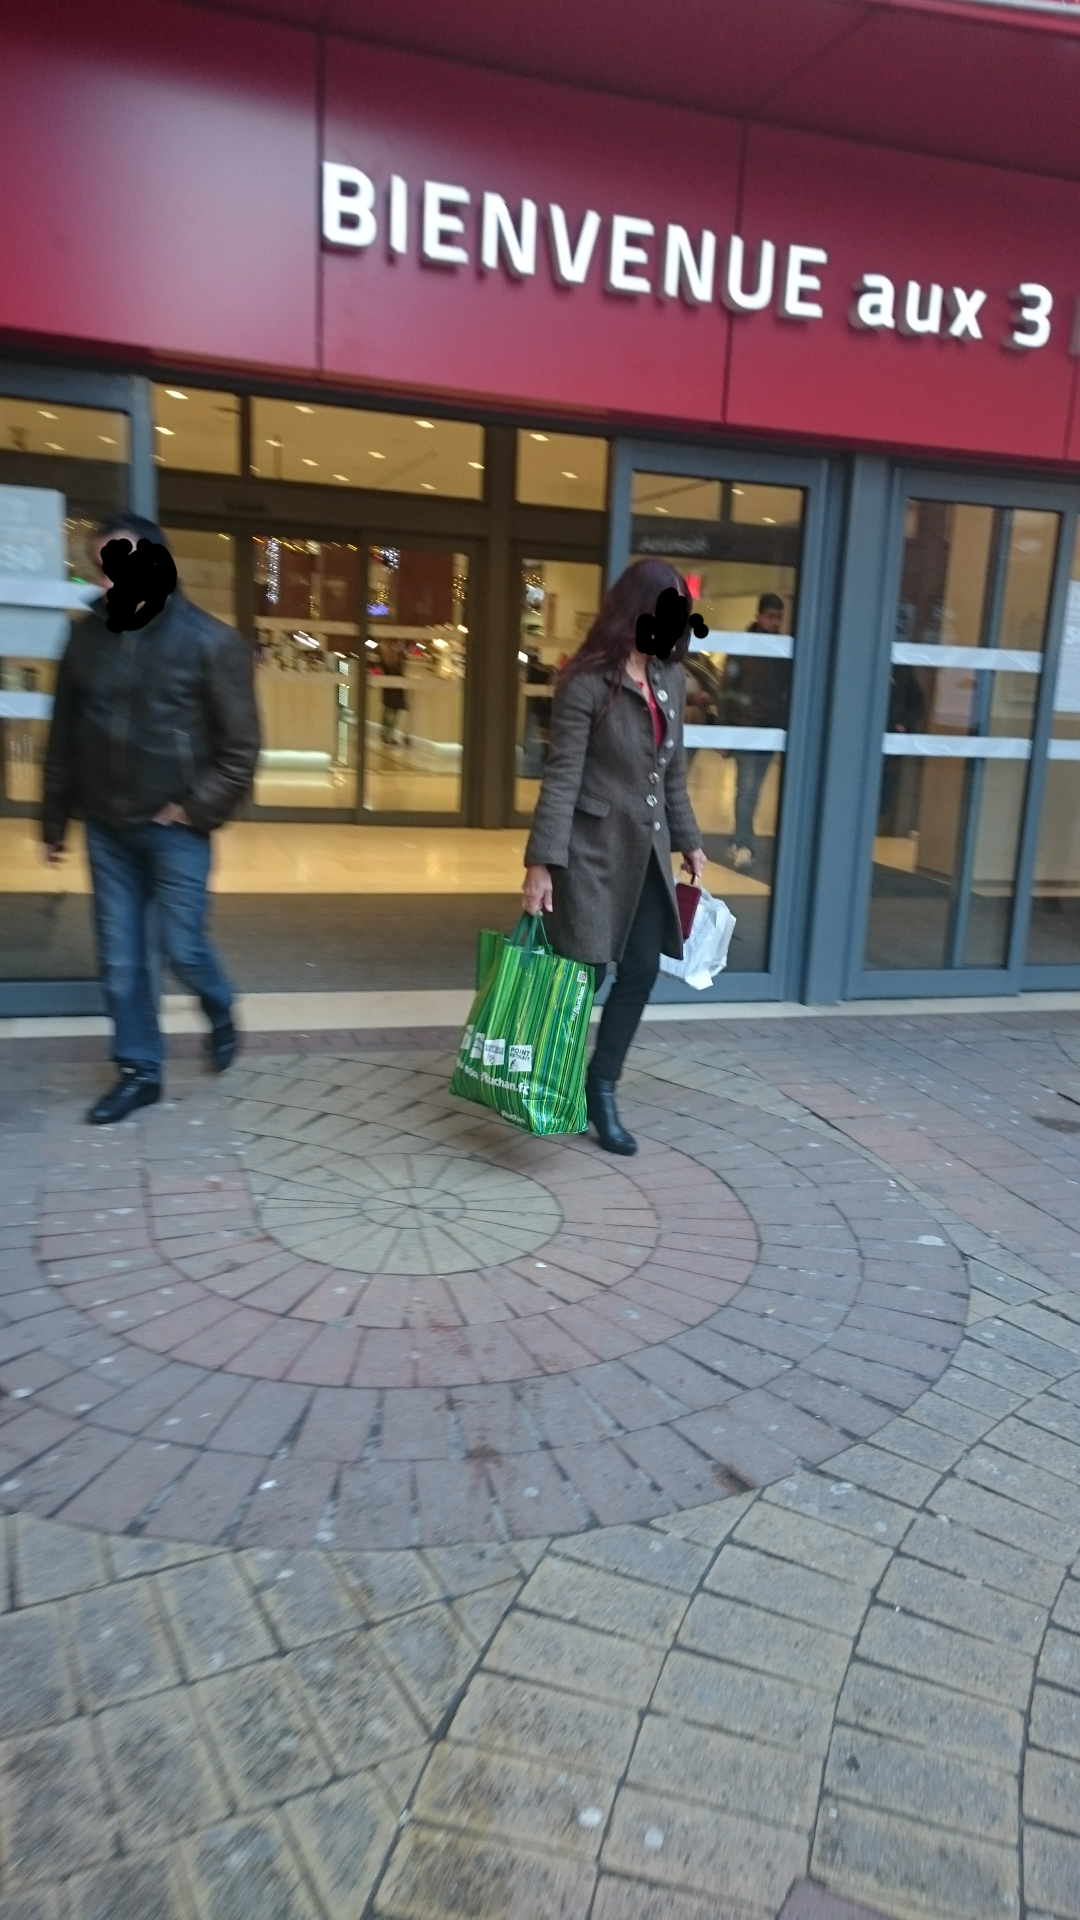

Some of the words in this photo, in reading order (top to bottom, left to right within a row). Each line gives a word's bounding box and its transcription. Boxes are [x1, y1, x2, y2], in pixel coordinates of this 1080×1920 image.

[322, 161, 829, 319] BIENVENUE
[857, 274, 988, 339] aux
[1012, 282, 1053, 348] 3
[510, 1046, 531, 1057] POINT
